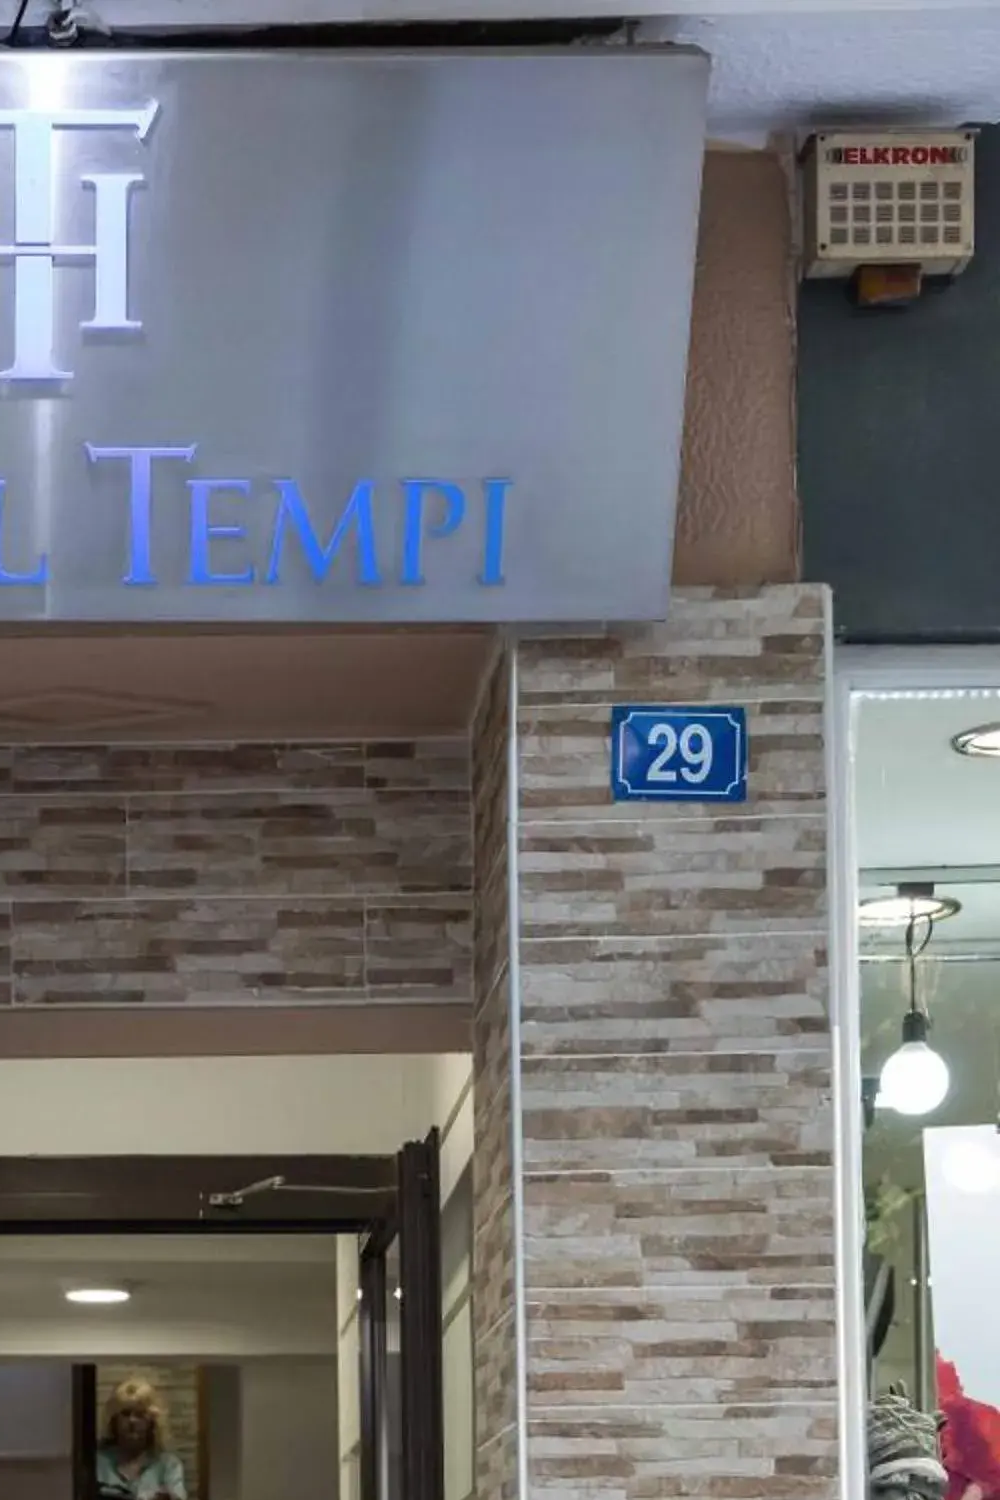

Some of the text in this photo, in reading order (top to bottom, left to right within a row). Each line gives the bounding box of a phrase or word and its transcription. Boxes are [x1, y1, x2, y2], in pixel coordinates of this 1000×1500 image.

[843, 146, 950, 165] ELKRON
[84, 441, 513, 586] TEMPI
[646, 723, 713, 784] 29
